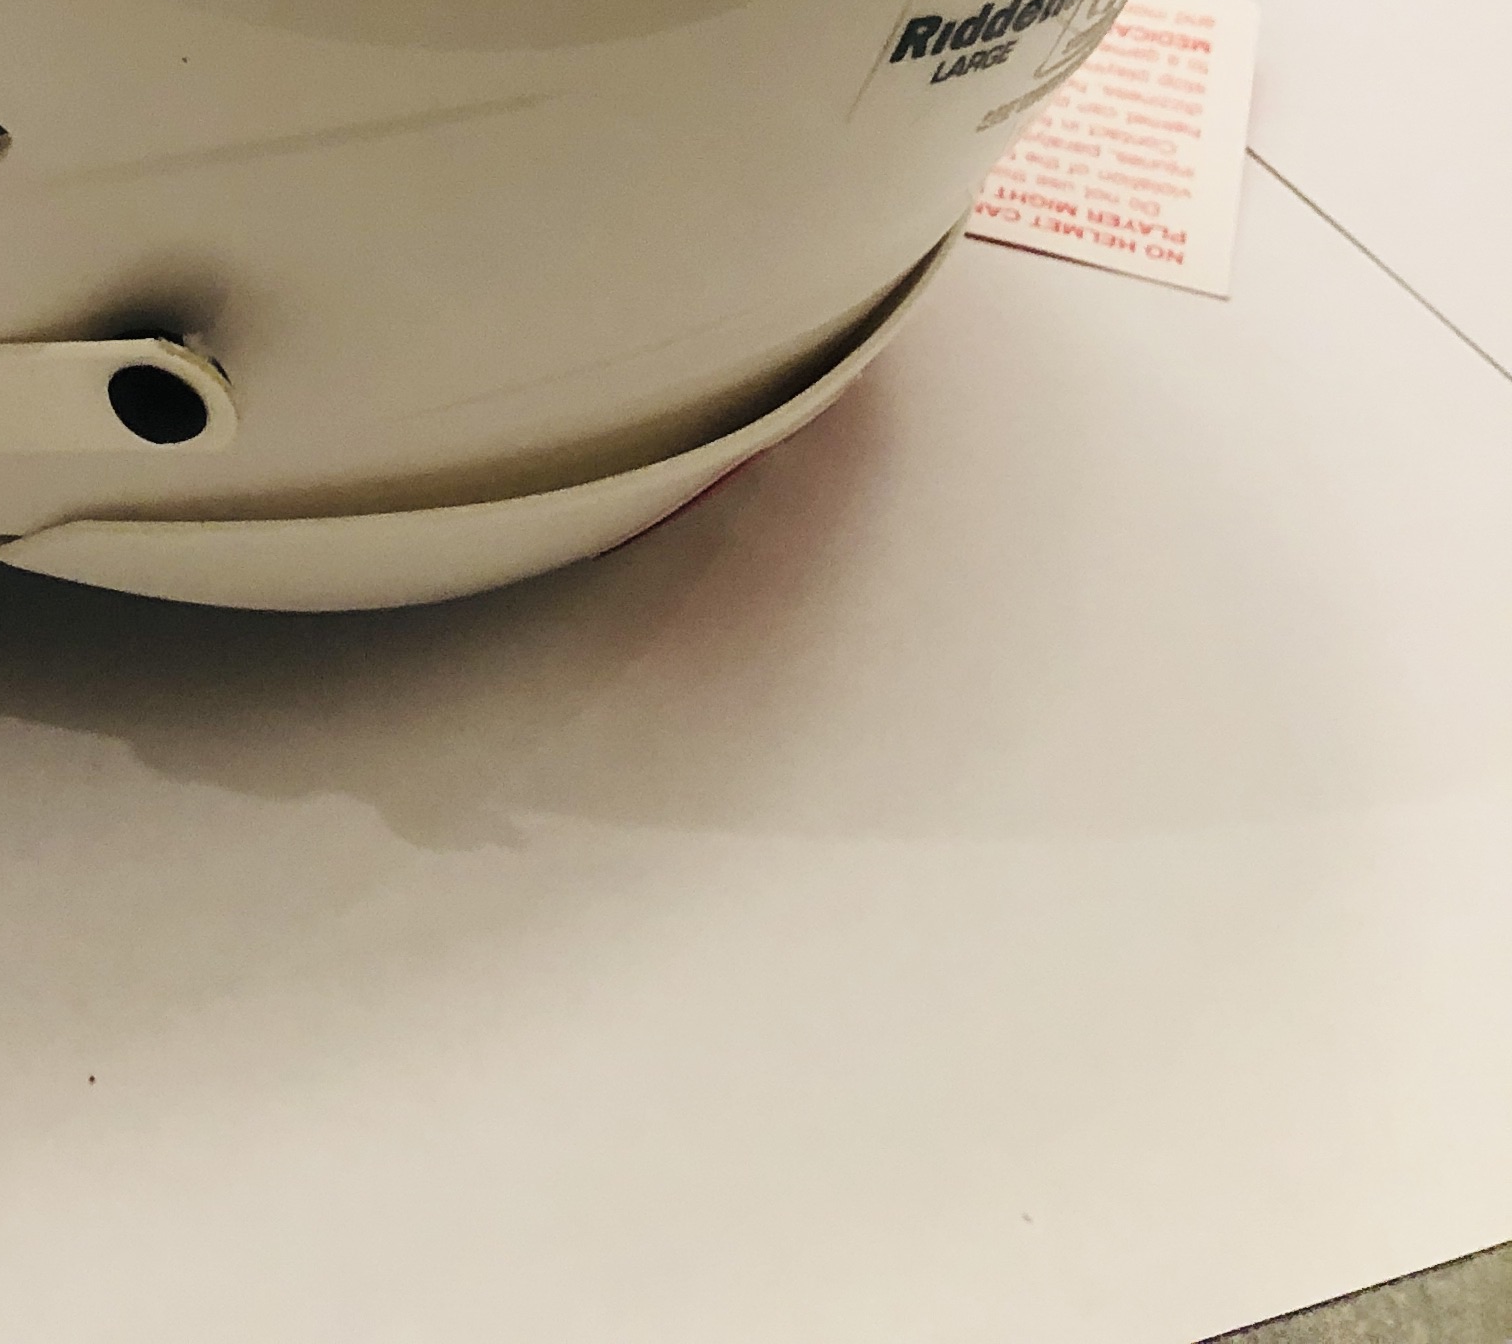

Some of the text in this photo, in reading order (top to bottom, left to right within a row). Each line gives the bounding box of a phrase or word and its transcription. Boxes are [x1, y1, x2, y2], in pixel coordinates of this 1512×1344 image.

[930, 40, 1017, 85] LARGE
[994, 186, 1187, 245] PLAYER MIGHT
[1029, 216, 1136, 253] HELMET
[1144, 243, 1185, 265] NO
